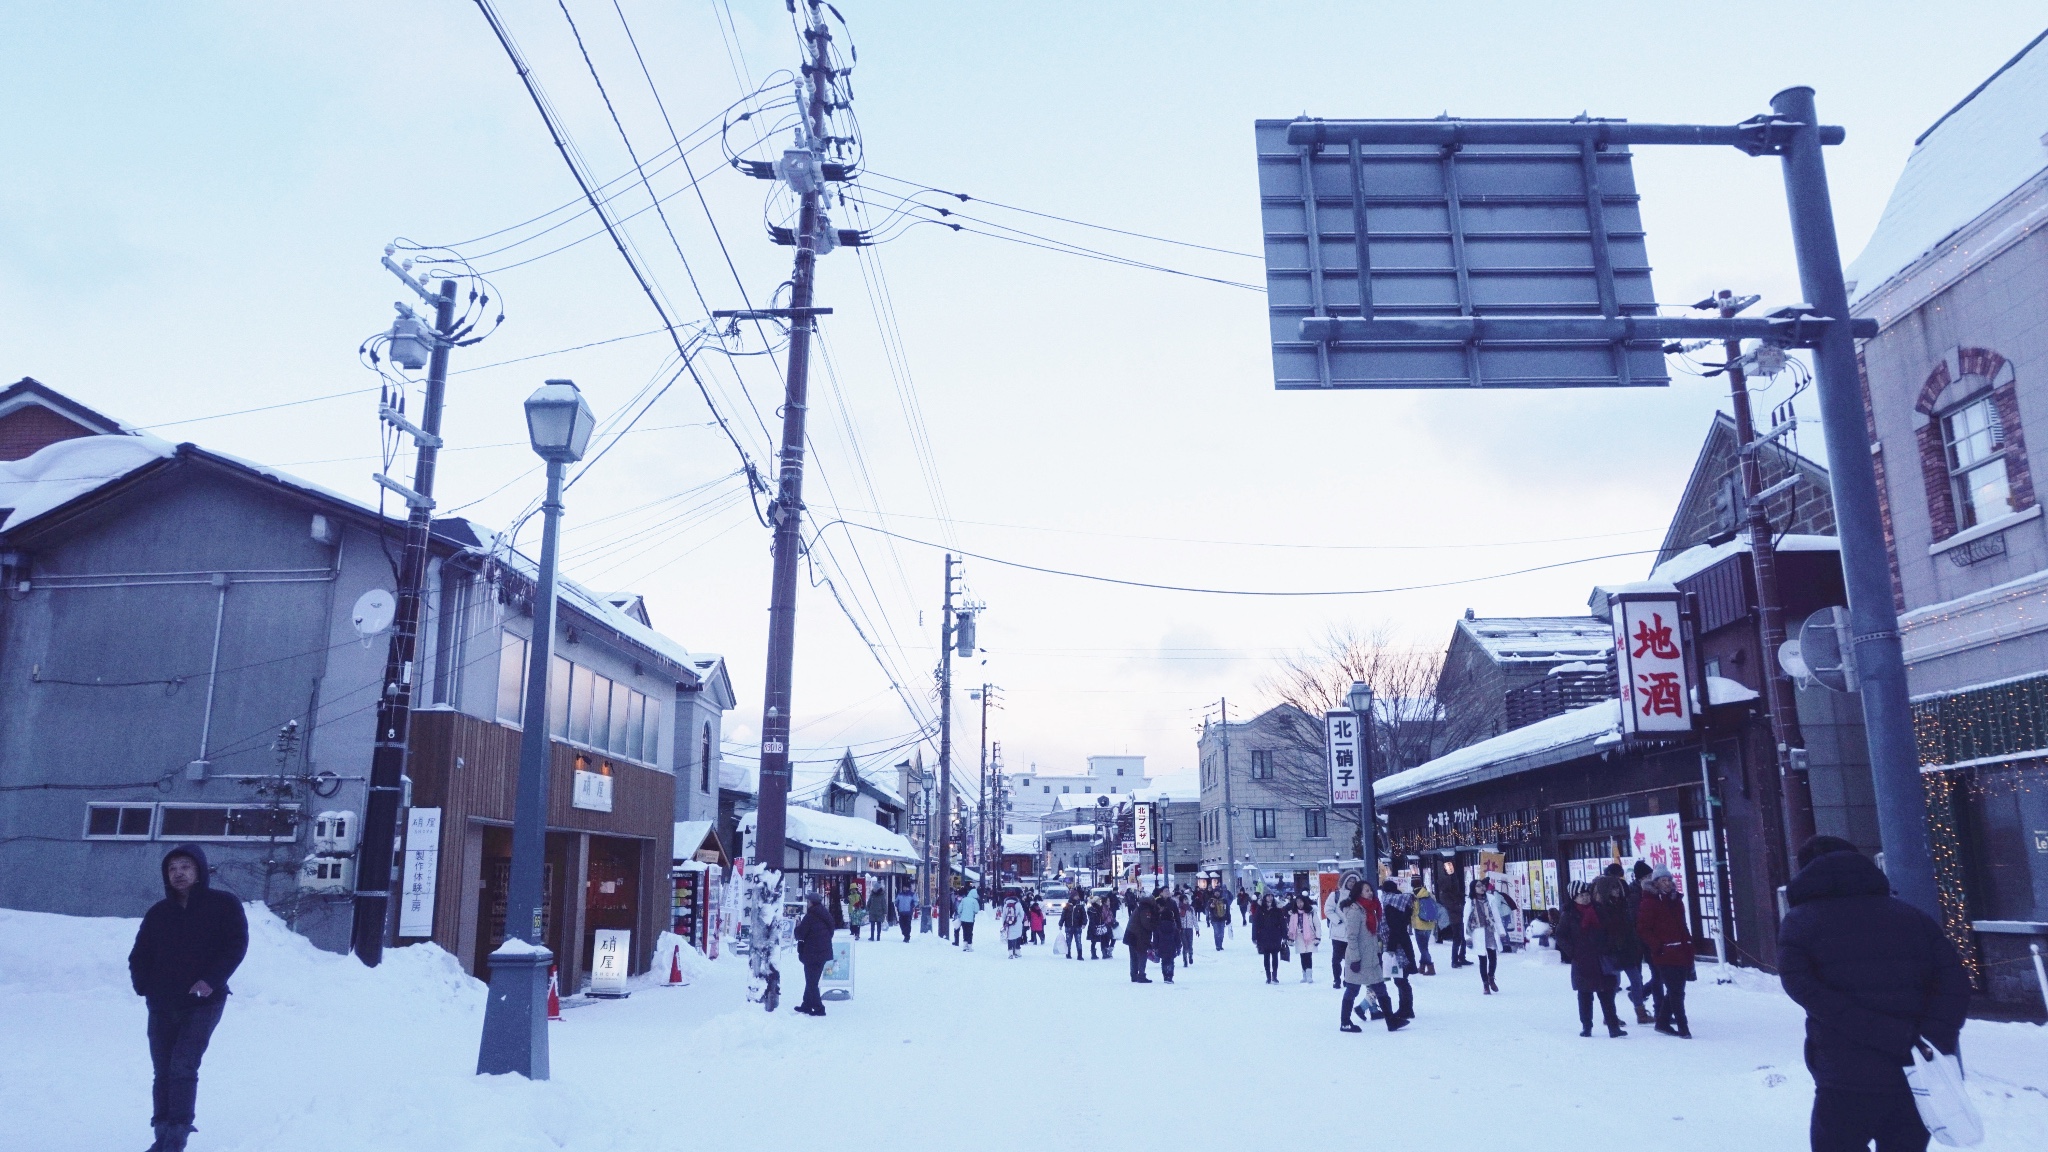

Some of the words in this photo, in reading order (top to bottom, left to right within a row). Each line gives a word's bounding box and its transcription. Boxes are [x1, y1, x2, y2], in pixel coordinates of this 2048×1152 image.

[1633, 612, 1683, 718] 地酒
[1333, 720, 1355, 787] 北一硝子
[1334, 790, 1359, 800] OUTLET
[411, 850, 424, 912] 製作体験工房
[600, 935, 617, 969] 硝屋
